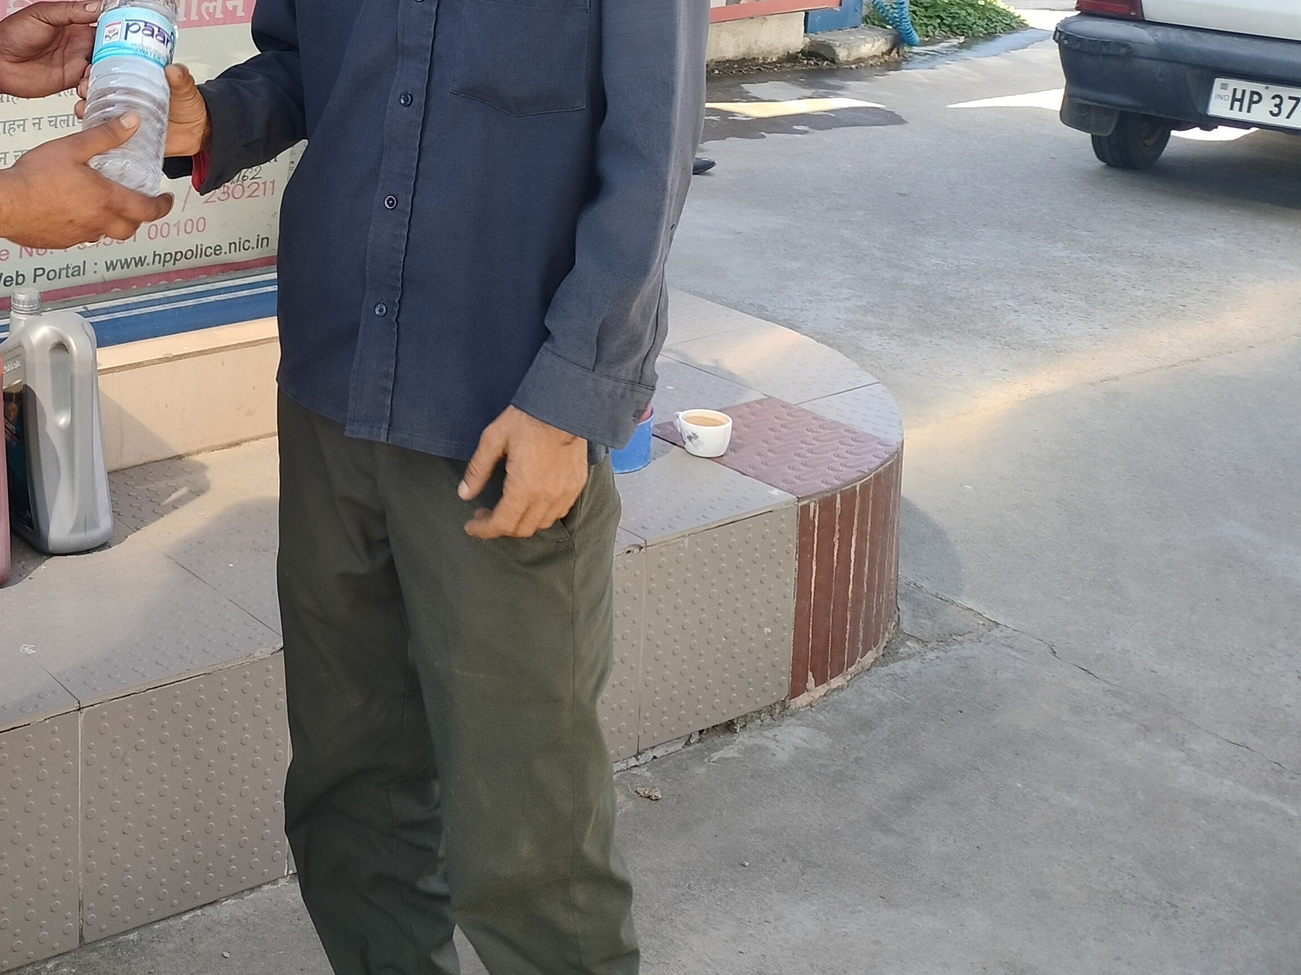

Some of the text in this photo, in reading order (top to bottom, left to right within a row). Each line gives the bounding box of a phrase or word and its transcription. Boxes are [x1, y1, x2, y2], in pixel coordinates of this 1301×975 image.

[1214, 93, 1230, 102] IND
[1229, 87, 1262, 113] HP
[33, 260, 87, 284] Portal
[104, 233, 270, 272] www.hppolice.nic.in
